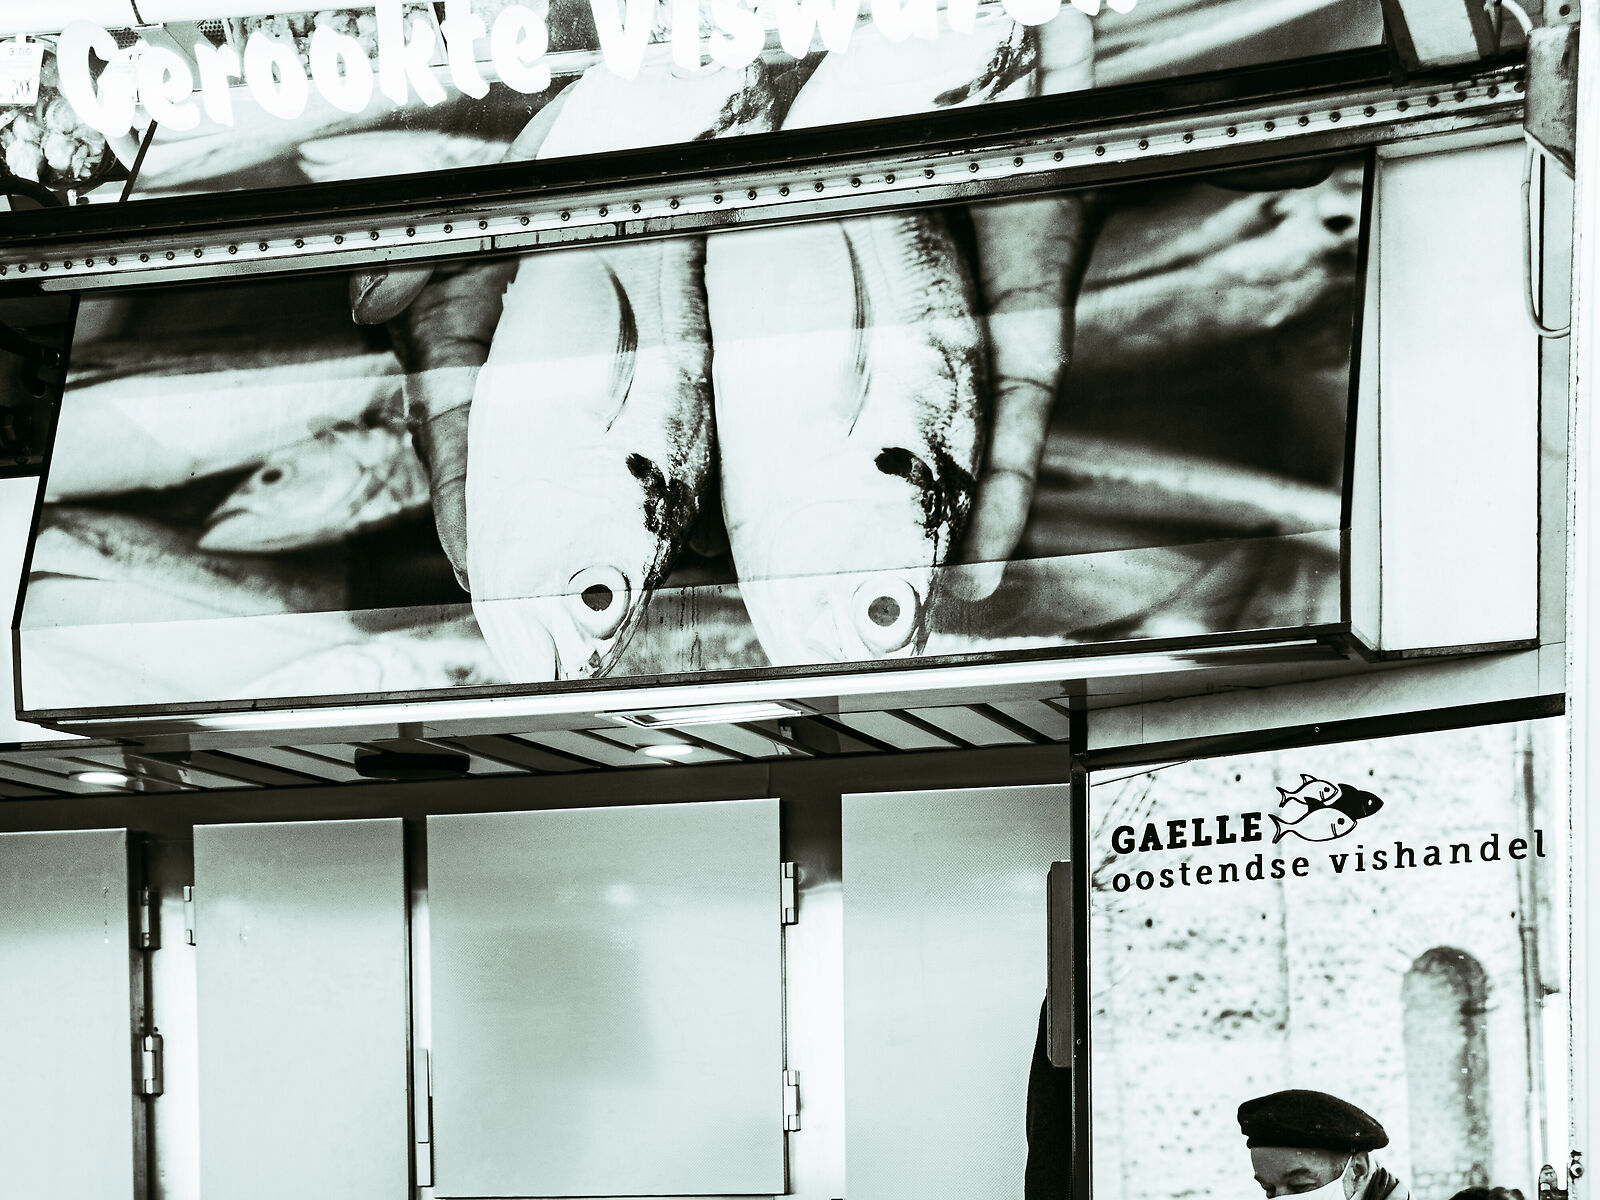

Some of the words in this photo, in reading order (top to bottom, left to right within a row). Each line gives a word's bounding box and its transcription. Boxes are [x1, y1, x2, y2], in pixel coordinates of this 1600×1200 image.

[57, 0, 551, 137] Gerookte
[1111, 811, 1263, 855] GAELLE
[1112, 853, 1310, 893] oostendse
[1329, 829, 1547, 873] vishandel
